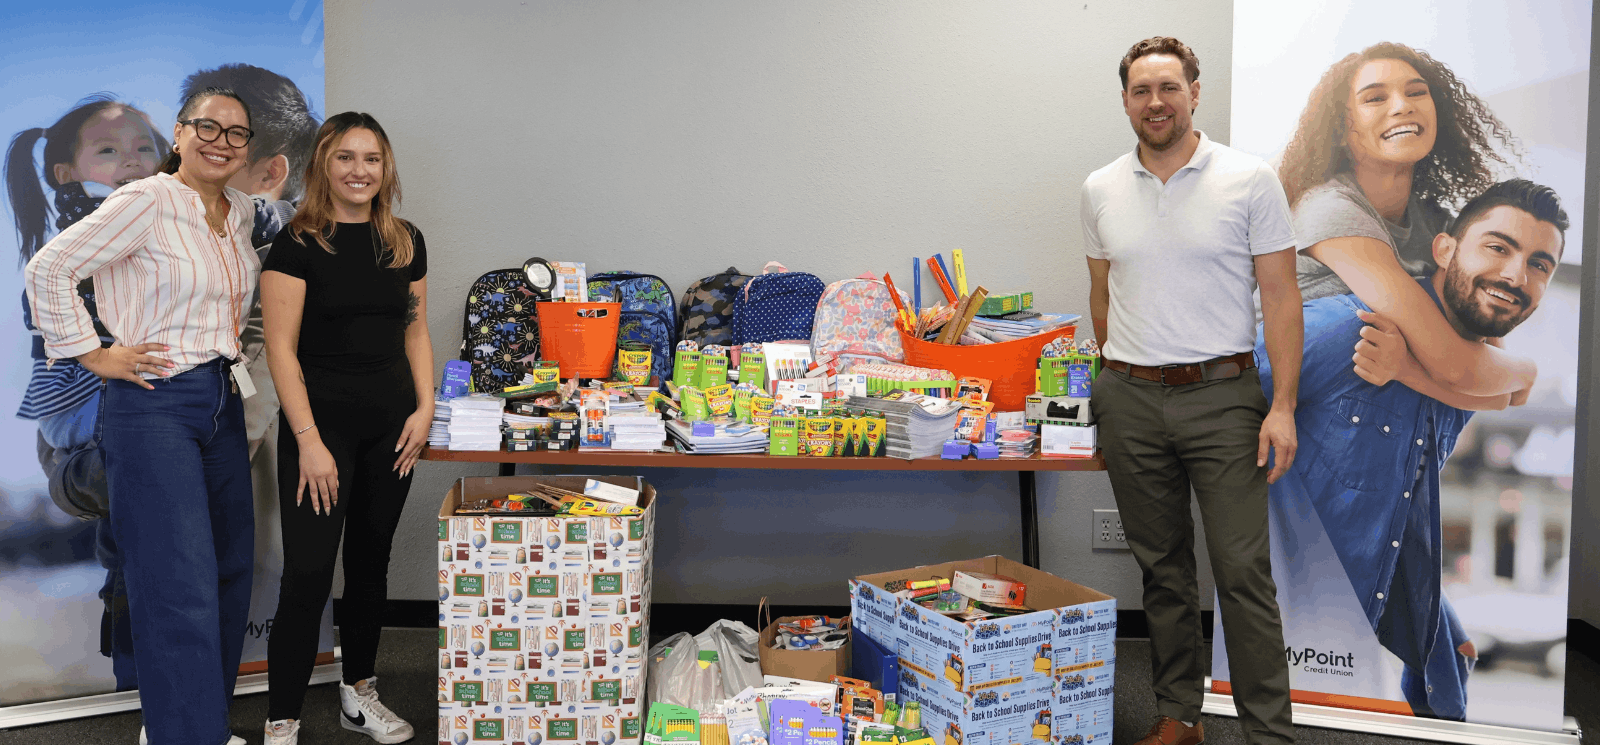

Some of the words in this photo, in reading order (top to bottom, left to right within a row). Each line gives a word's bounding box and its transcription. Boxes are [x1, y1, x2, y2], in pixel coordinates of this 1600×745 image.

[883, 611, 895, 624] Suppli
[899, 619, 908, 631] Back
[910, 625, 914, 633] to
[915, 626, 928, 640] School
[930, 632, 947, 648] Supplies
[949, 640, 960, 653] Drive
[1059, 628, 1071, 638] Back
[1080, 623, 1096, 634] School
[972, 643, 986, 653] Back
[995, 638, 1014, 649] School
[1015, 635, 1037, 646] Supplies
[1038, 632, 1052, 641] Drive
[1304, 666, 1328, 674] Credit
[1330, 669, 1353, 677] Union
[1060, 693, 1072, 704] Back
[1074, 693, 1079, 702] to
[1080, 689, 1096, 700] School
[947, 709, 959, 722] Drive
[972, 711, 985, 721] Back
[987, 710, 992, 718] to
[994, 705, 1012, 717] School
[1014, 701, 1036, 714] Supplies
[1037, 699, 1049, 708] Drive
[728, 720, 734, 728] 2
